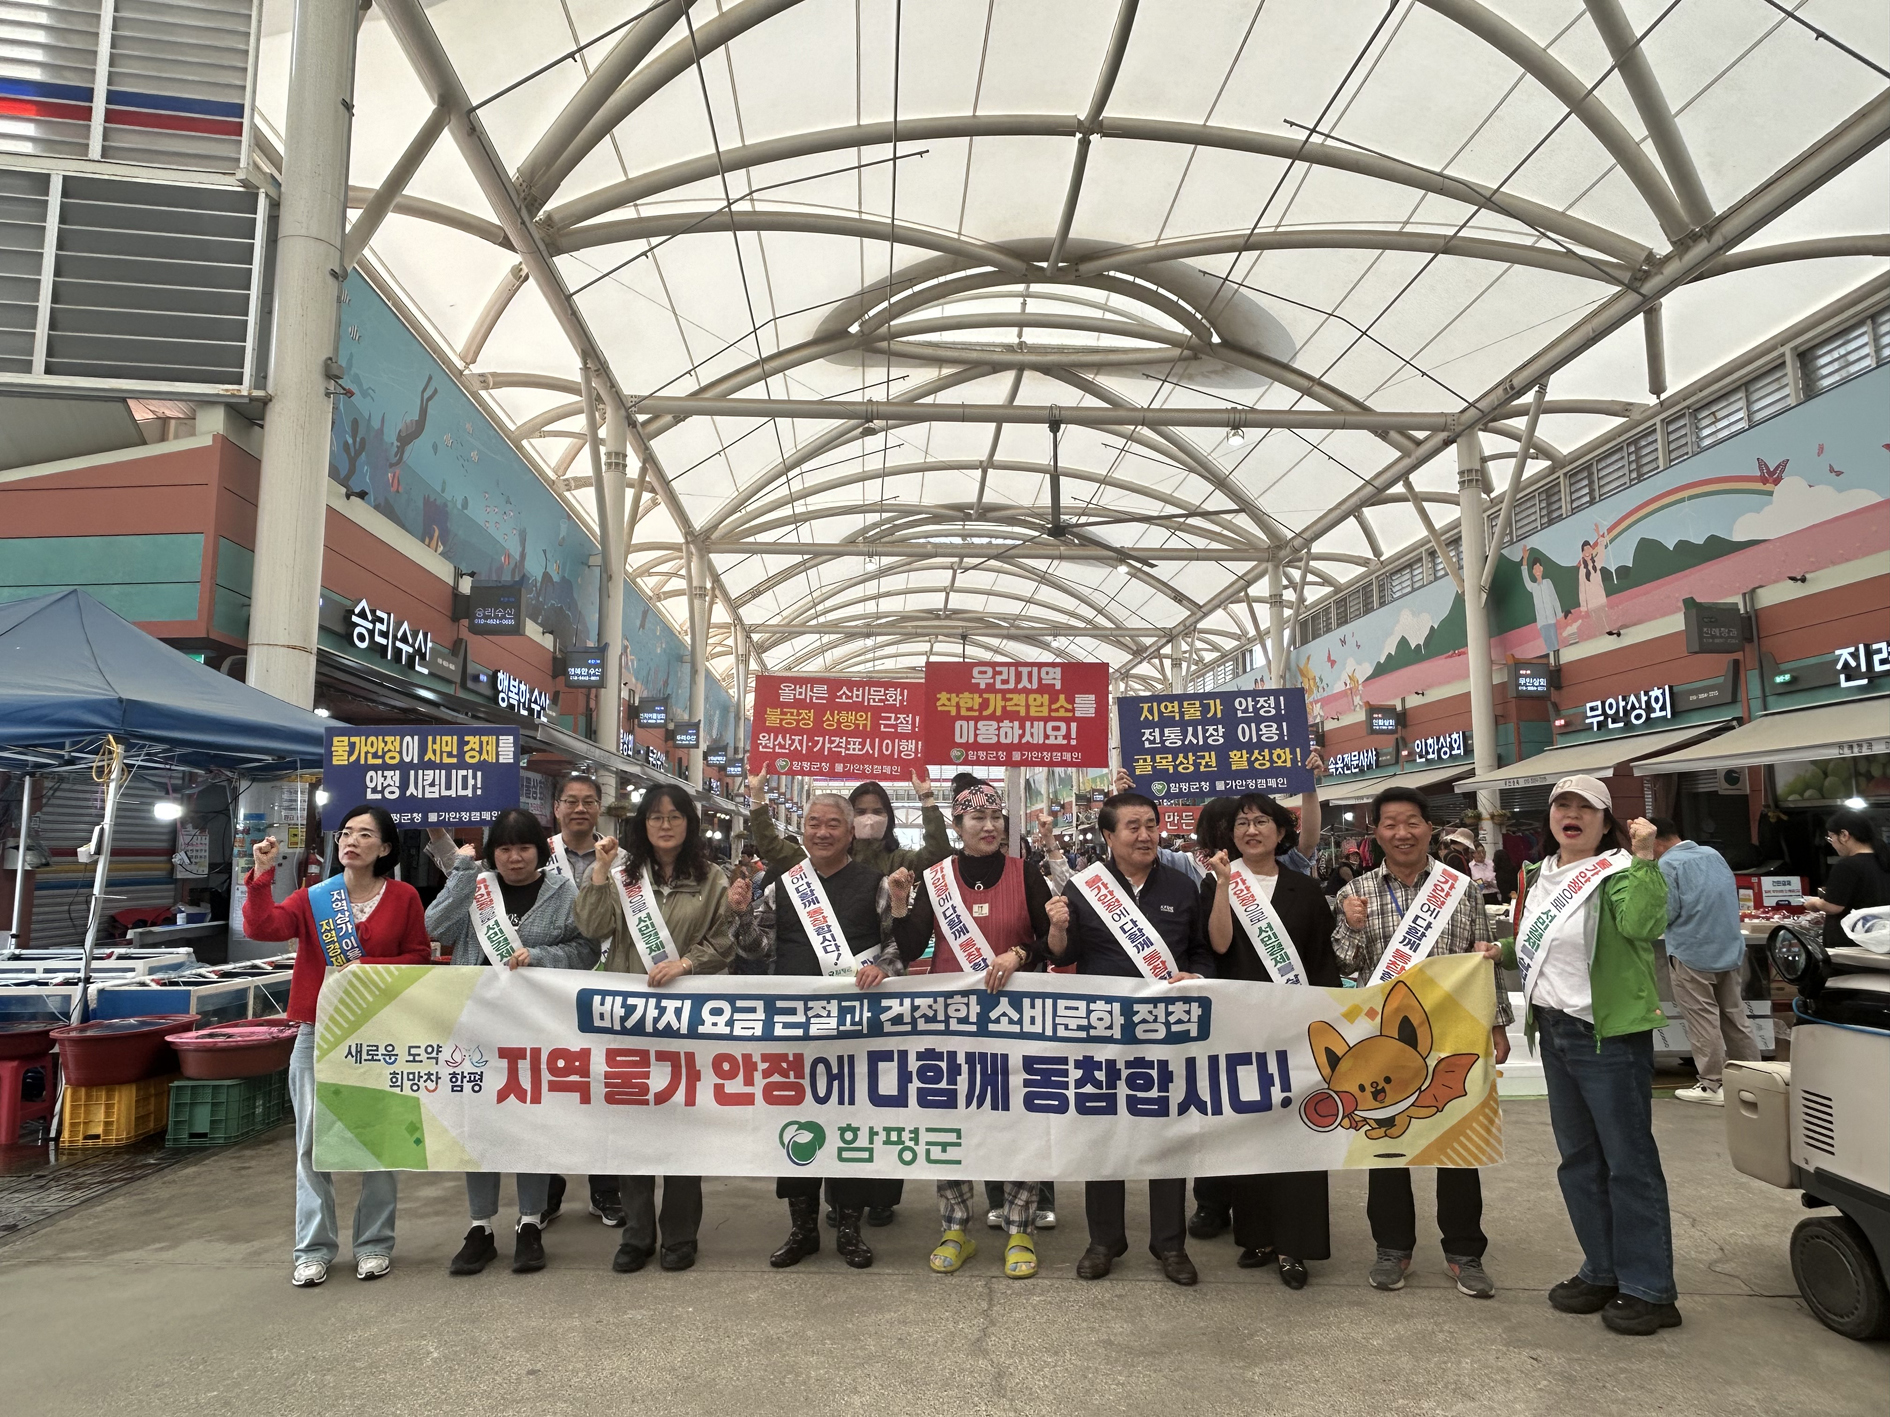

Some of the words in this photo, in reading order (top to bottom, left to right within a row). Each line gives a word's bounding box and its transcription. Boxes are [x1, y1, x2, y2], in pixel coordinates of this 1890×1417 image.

[474, 607, 515, 618] 승리수산
[352, 598, 432, 675] 승리수산
[971, 666, 1061, 689] 우리지역
[497, 669, 530, 716] 행복한
[531, 687, 550, 723] 수산
[778, 683, 829, 703] 올바른
[835, 686, 908, 707] 소비문화!
[936, 691, 1097, 718] 착한가격업소를
[1139, 698, 1224, 722] 지역물가
[1234, 696, 1286, 717] 안정!
[1585, 684, 1672, 731] 무안상회
[764, 707, 814, 729] 불공정
[822, 710, 871, 731] 상행위
[879, 712, 920, 733] 근절!
[954, 720, 1078, 745] 이용하세요!
[1141, 724, 1226, 748] 전통시장
[1237, 721, 1288, 743] 이용!
[331, 735, 419, 765] 물가안정이
[424, 735, 458, 764] 서민
[463, 735, 515, 763] 경제를
[882, 738, 922, 760] 이행!
[1132, 751, 1218, 775] 골목상권
[1228, 747, 1302, 770] 활성화!
[1415, 730, 1464, 762] 인화상회
[365, 769, 400, 800] 안정
[405, 769, 482, 798] 시킵니다!
[1164, 812, 1195, 830] 만든
[794, 881, 821, 910] 다함께
[330, 889, 352, 936] 지역상가
[942, 904, 970, 941] 다함께
[636, 912, 669, 965] 서민경제
[806, 906, 842, 967] 동참합시다!
[1119, 918, 1154, 954] 다함께
[1257, 922, 1295, 977] 서민경제
[1398, 914, 1433, 954] 다함께
[1520, 908, 1557, 962] 서민경제
[592, 995, 692, 1034] 바가지
[697, 999, 766, 1036] 요금
[773, 999, 871, 1037] 근절과
[880, 995, 980, 1034] 건전한
[988, 997, 1125, 1040] 소비문화
[1132, 1001, 1202, 1040] 정착
[344, 1042, 399, 1065] 새로운
[405, 1043, 442, 1066] 도약
[388, 1070, 441, 1094] 희망찬
[448, 1070, 484, 1094] 함평
[495, 1046, 592, 1105] 지역
[602, 1047, 701, 1107] 물가
[711, 1051, 856, 1107] 안정에
[866, 1047, 1010, 1112] 다함께
[1021, 1049, 1293, 1118] 동참합시다!
[836, 1121, 963, 1166] 함평군
